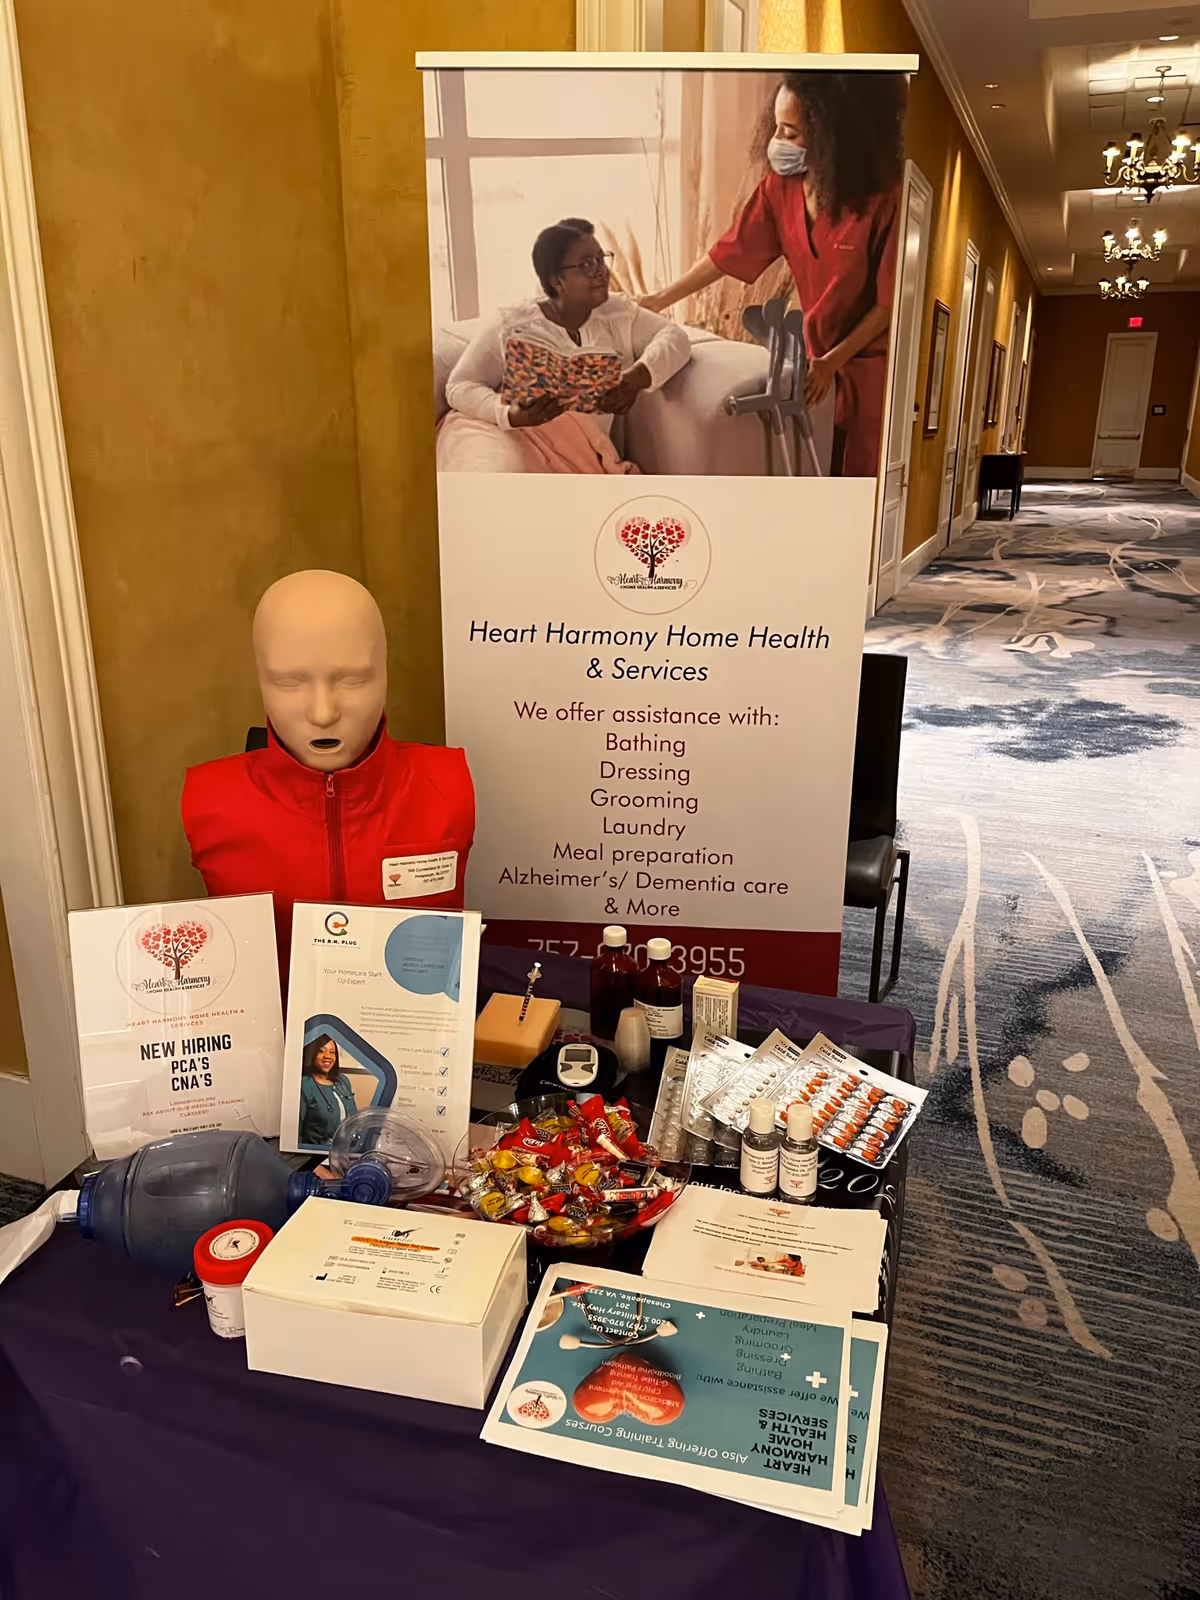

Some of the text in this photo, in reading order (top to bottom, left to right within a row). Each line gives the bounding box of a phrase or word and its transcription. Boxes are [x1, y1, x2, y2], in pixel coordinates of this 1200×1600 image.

[469, 620, 830, 652] Heart Harmony Home Health
[586, 657, 709, 682] & Services
[514, 700, 780, 726] We offer assistance with:
[606, 732, 686, 758] Bathing
[600, 762, 691, 786] Dressing
[590, 788, 699, 814] Grooming
[602, 817, 686, 841] Laundry
[553, 842, 734, 868] Meal preparation
[499, 868, 789, 895] Alzheimer's/ Dementia care
[604, 898, 680, 917] & More
[528, 938, 746, 977] 7-703955
[324, 968, 382, 978] Your Homecare Start
[346, 978, 366, 986] Expert
[211, 1009, 238, 1018] HEALTH
[140, 1034, 232, 1060] NEW HIRING
[171, 1056, 210, 1074] PCA'S
[172, 1073, 212, 1092] CNA'S
[605, 1290, 616, 1298] VA
[619, 1293, 671, 1309] Chesapeake,
[587, 1304, 606, 1314] Hwy
[606, 1308, 640, 1320] Military
[616, 1302, 630, 1310] 201
[588, 1314, 624, 1327] 970-3955
[719, 1309, 817, 1333] Meal Preparation
[590, 1323, 639, 1339] Contact Us:
[742, 1325, 790, 1341] Laundry
[734, 1335, 794, 1354] Grooming
[736, 1348, 788, 1368] Dressing
[601, 1360, 682, 1380] Bloodborne Pathogen
[608, 1370, 668, 1386] G-Tube Training
[736, 1362, 782, 1380] Bathing
[696, 1373, 839, 1409] We offer assistance with:
[758, 1408, 828, 1429] SERVICES
[758, 1420, 827, 1441] HEALTH &
[566, 1418, 748, 1464] Also Offering Training Courses
[768, 1433, 813, 1450] HOME
[750, 1442, 828, 1466] HARMONY
[764, 1458, 812, 1476] HEART
